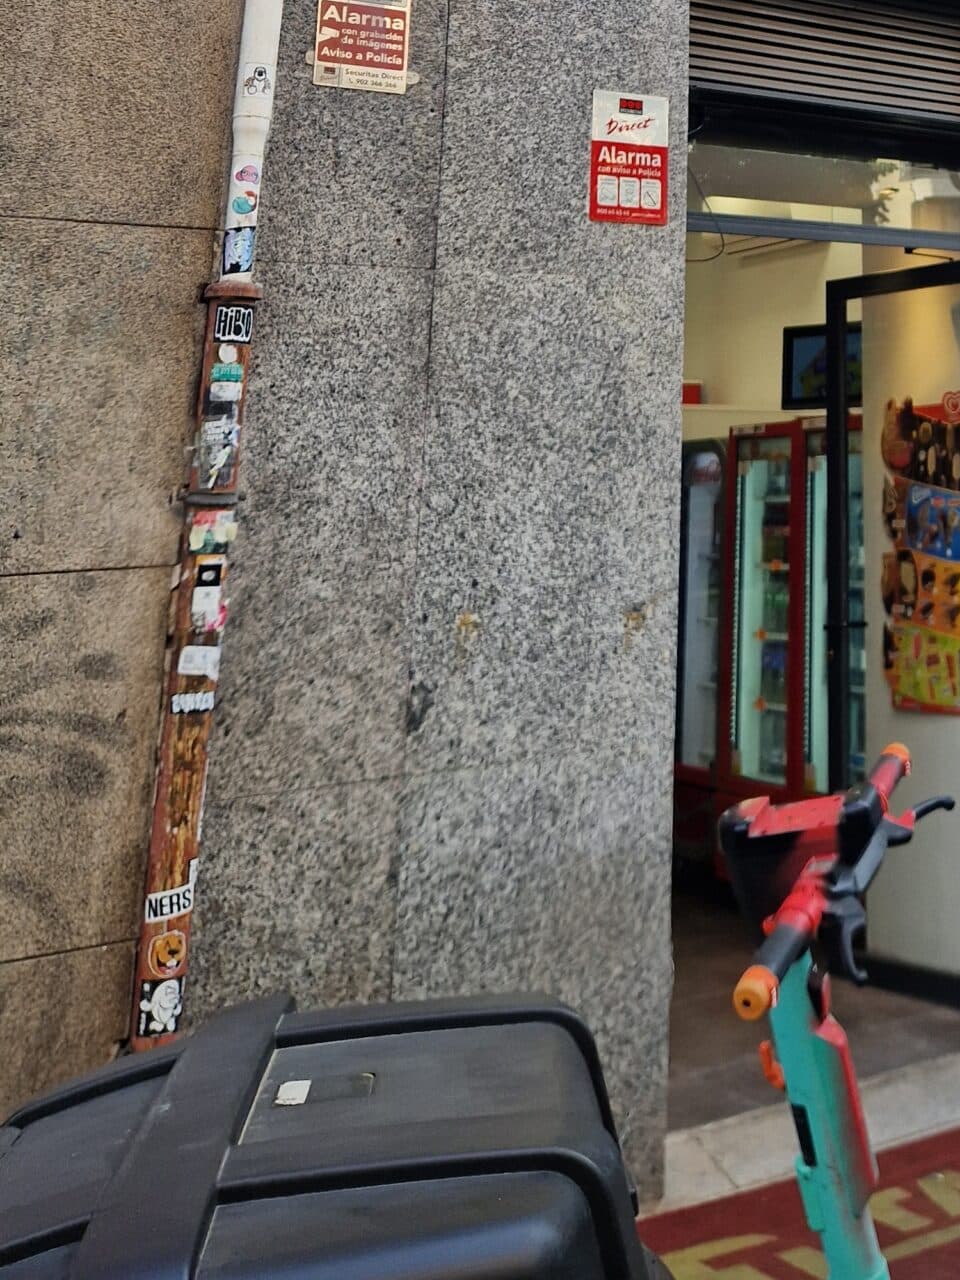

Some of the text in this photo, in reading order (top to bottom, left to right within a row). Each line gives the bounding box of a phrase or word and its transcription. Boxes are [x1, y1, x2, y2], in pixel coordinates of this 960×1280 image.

[322, 4, 405, 31] Alarma
[341, 28, 404, 41] con grabación
[341, 35, 403, 51] de imágenes
[321, 46, 353, 59] Aviso
[366, 51, 402, 65] Policía
[345, 68, 379, 79] Securitas
[381, 72, 404, 81] Direct
[606, 117, 656, 135] Direct
[598, 145, 662, 167] Alarma
[148, 889, 192, 919] NERS
